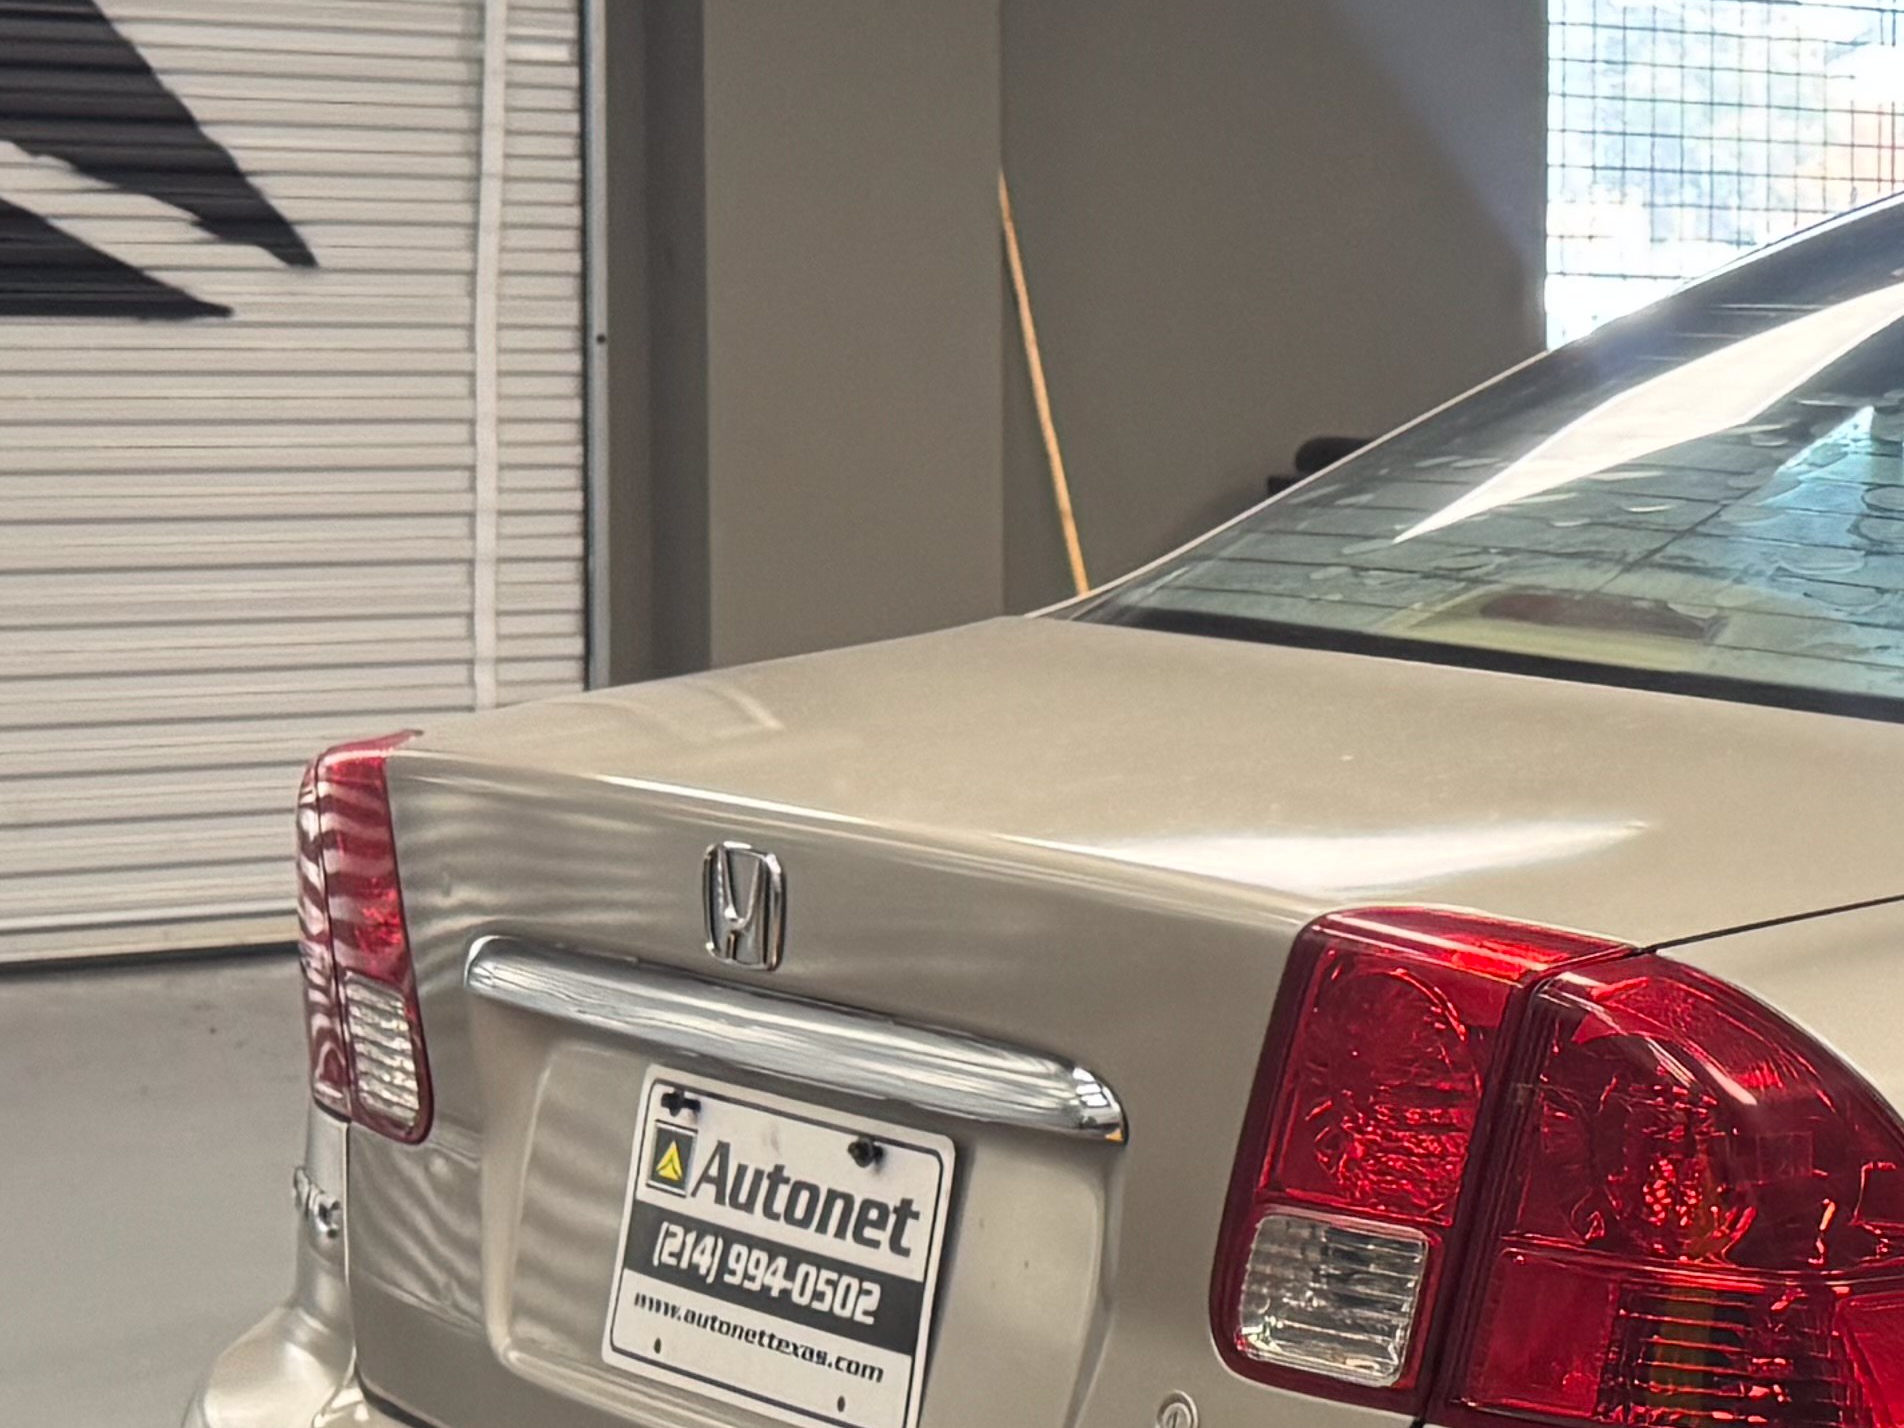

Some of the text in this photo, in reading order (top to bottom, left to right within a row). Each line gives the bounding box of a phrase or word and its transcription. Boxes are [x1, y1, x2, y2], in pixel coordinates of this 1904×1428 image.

[691, 1139, 921, 1257] Autonet
[653, 1221, 881, 1324] (214) 994-0502
[634, 1291, 884, 1383] www.autonettexas.com
